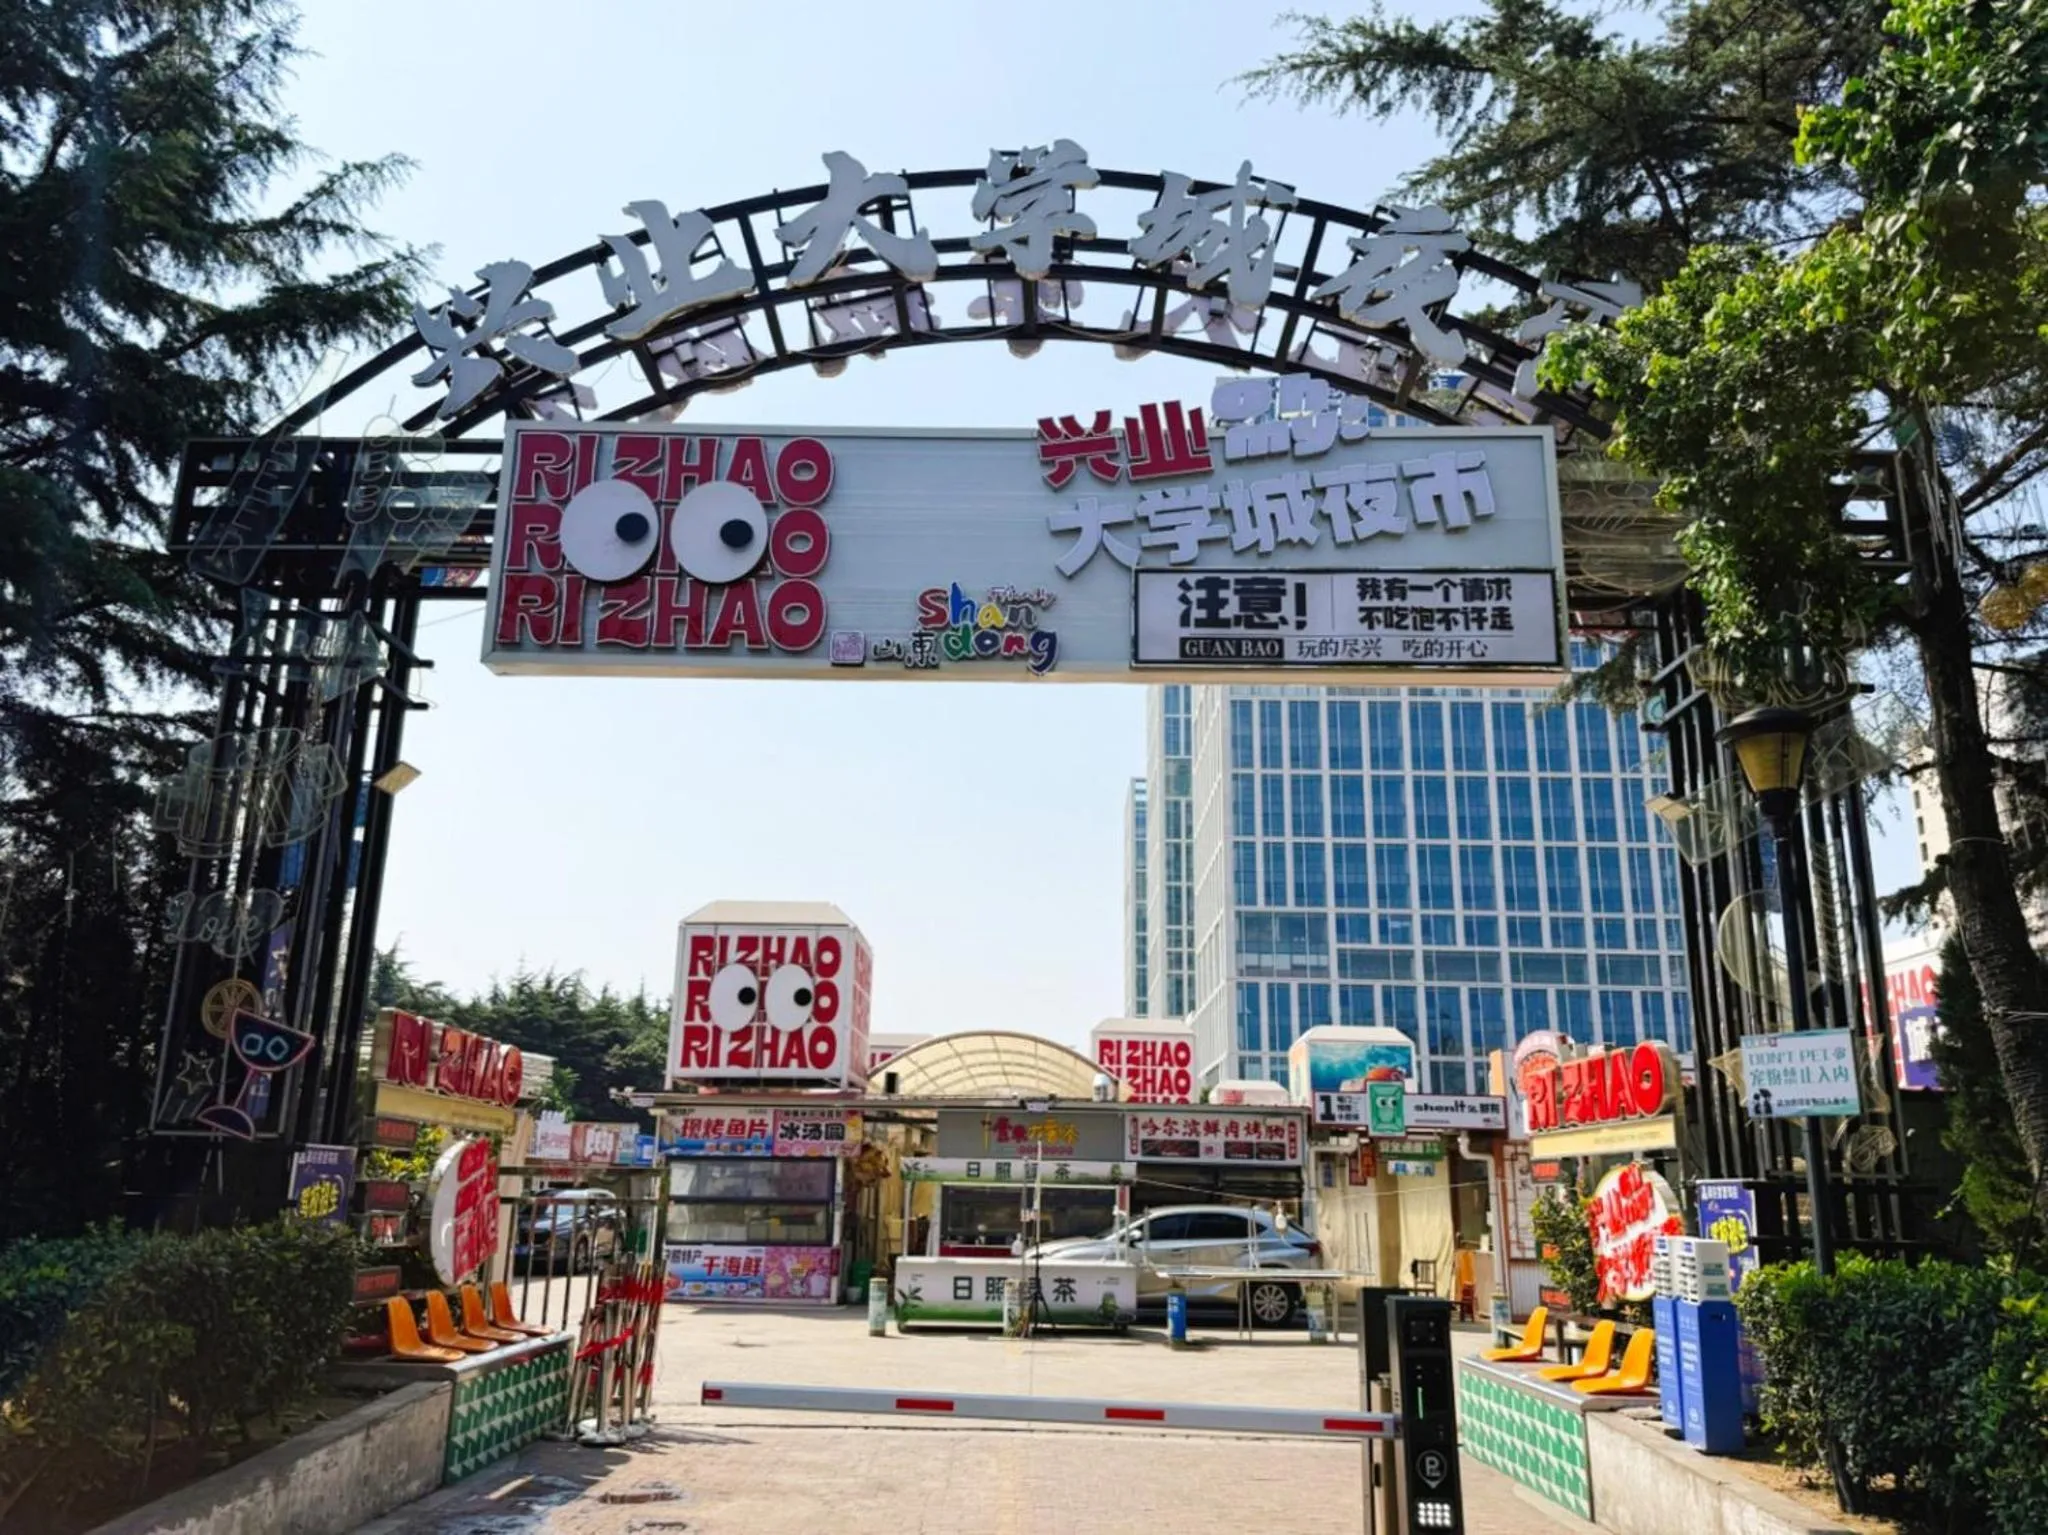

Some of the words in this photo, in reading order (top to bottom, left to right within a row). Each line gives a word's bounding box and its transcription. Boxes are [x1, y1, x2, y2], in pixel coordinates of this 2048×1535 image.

[1037, 400, 1213, 489] 兴业
[512, 432, 834, 506] RIZHAO
[1047, 450, 1495, 577] 大学城夜市
[1356, 576, 1514, 602] 我有一个请求
[496, 573, 828, 652] RIZHAO
[1357, 604, 1515, 631] 不吃饱不许走
[943, 622, 1058, 676] dong
[1184, 638, 1238, 658] GUAN
[1241, 638, 1281, 658] BAO
[1298, 637, 1383, 658] 玩的尽兴
[1402, 638, 1488, 660] 吃的开心
[689, 935, 843, 978] RIZHAO
[387, 1010, 524, 1106] RIZHAO
[680, 1024, 838, 1070] RIZHAO
[1098, 1039, 1192, 1069] RIZHAO
[1108, 1066, 1192, 1096] ZHAO
[1526, 1041, 1664, 1130] RIZHAO
[682, 1117, 768, 1139] 现烤鱼片
[780, 1123, 846, 1140] 冰汤圆
[1141, 1116, 1285, 1139] 哈尔滨鲜肉烤肠
[703, 1255, 763, 1277] 干海鲜
